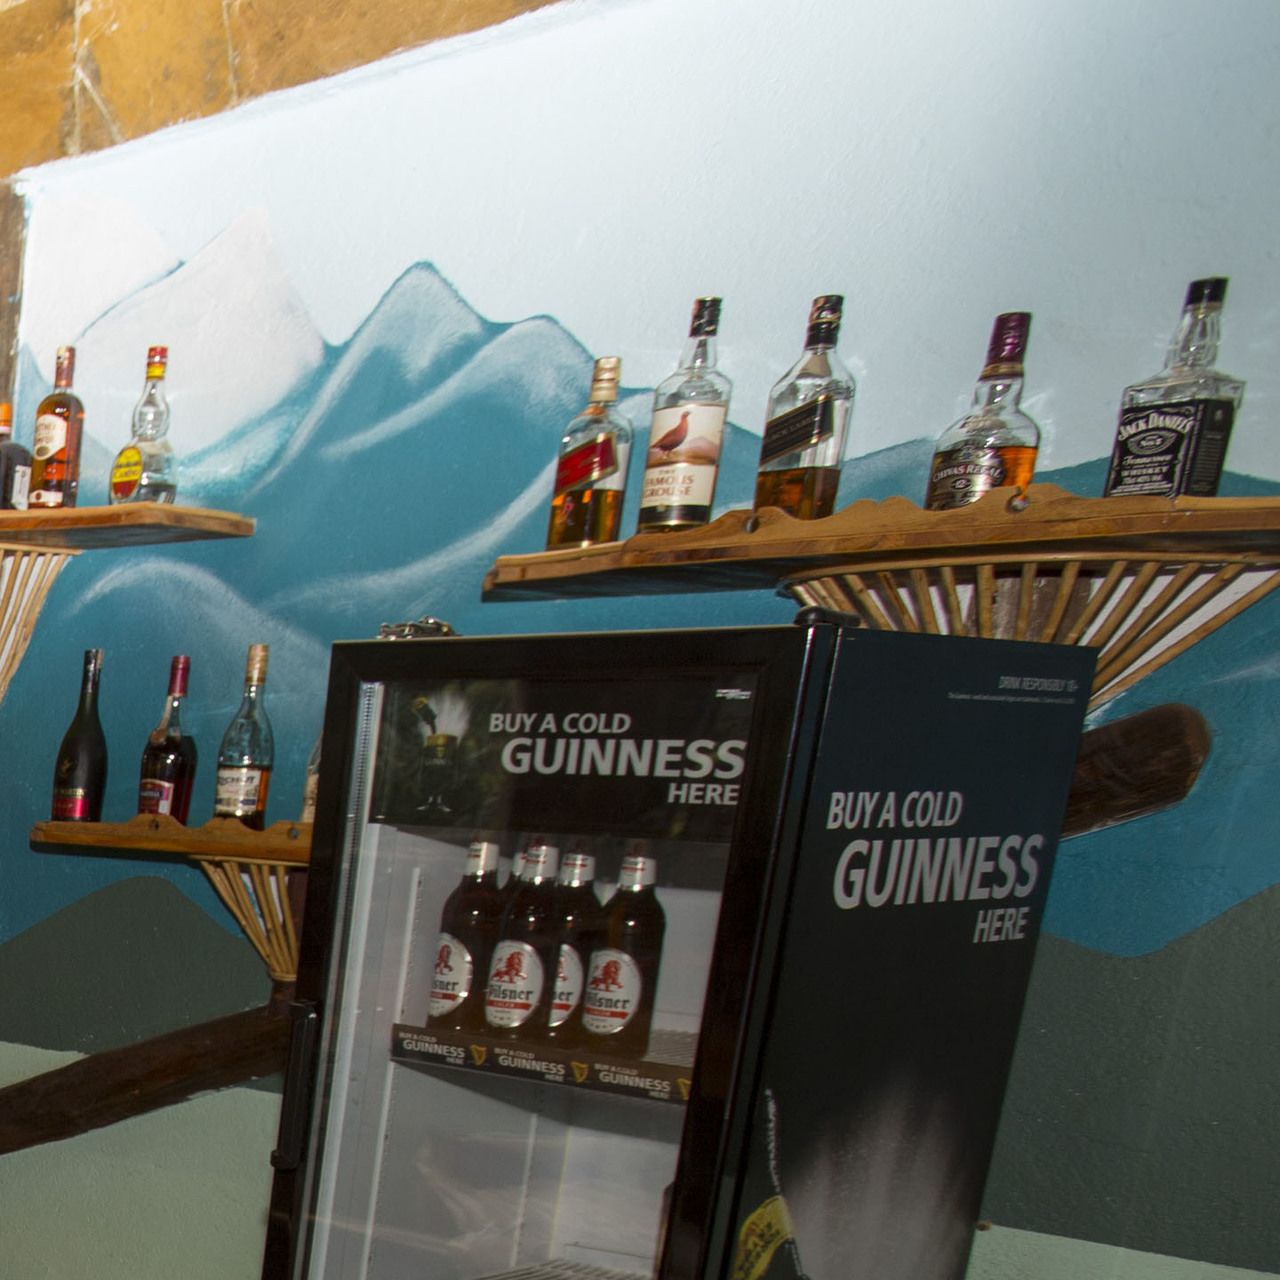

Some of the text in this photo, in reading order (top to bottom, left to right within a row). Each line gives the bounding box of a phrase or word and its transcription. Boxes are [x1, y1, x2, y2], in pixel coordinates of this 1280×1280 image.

[488, 712, 632, 735] BUY A COLD
[500, 737, 748, 779] GUINNESS
[666, 782, 741, 806] HERE
[825, 790, 964, 830] BUY A COLD
[833, 833, 1045, 910] GUINNESS
[972, 905, 1031, 944] HERE
[487, 983, 535, 1001] Pilsner
[402, 1038, 466, 1059] GUINNESS
[498, 1055, 566, 1076] GUINNESS
[598, 1071, 672, 1092] GUINNESS
